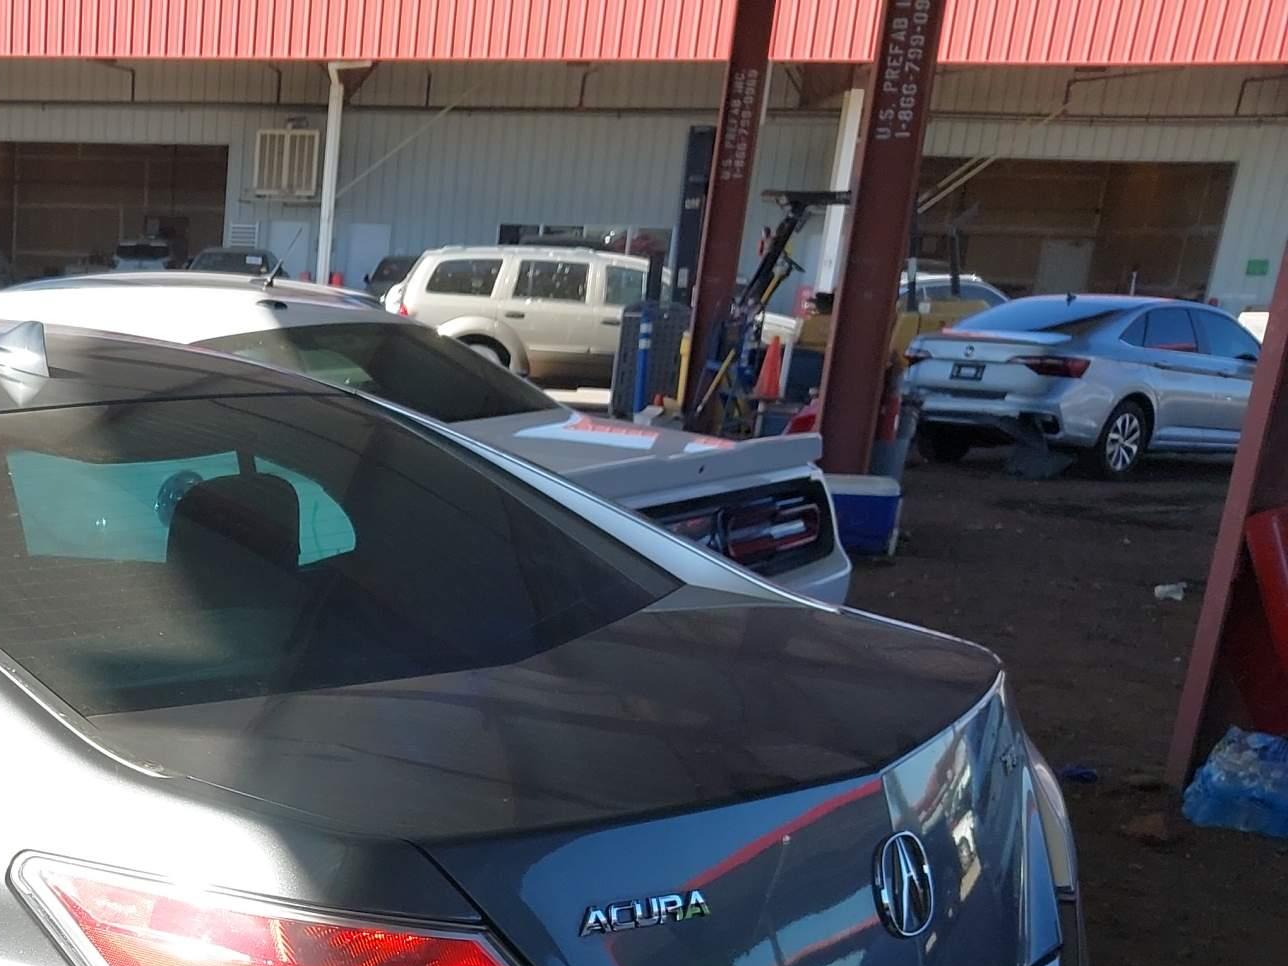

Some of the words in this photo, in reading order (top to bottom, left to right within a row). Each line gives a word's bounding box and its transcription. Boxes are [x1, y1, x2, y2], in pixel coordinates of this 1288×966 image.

[882, 16, 910, 93] PREFAB
[875, 101, 897, 140] U.S.
[579, 888, 711, 937] ACURA
